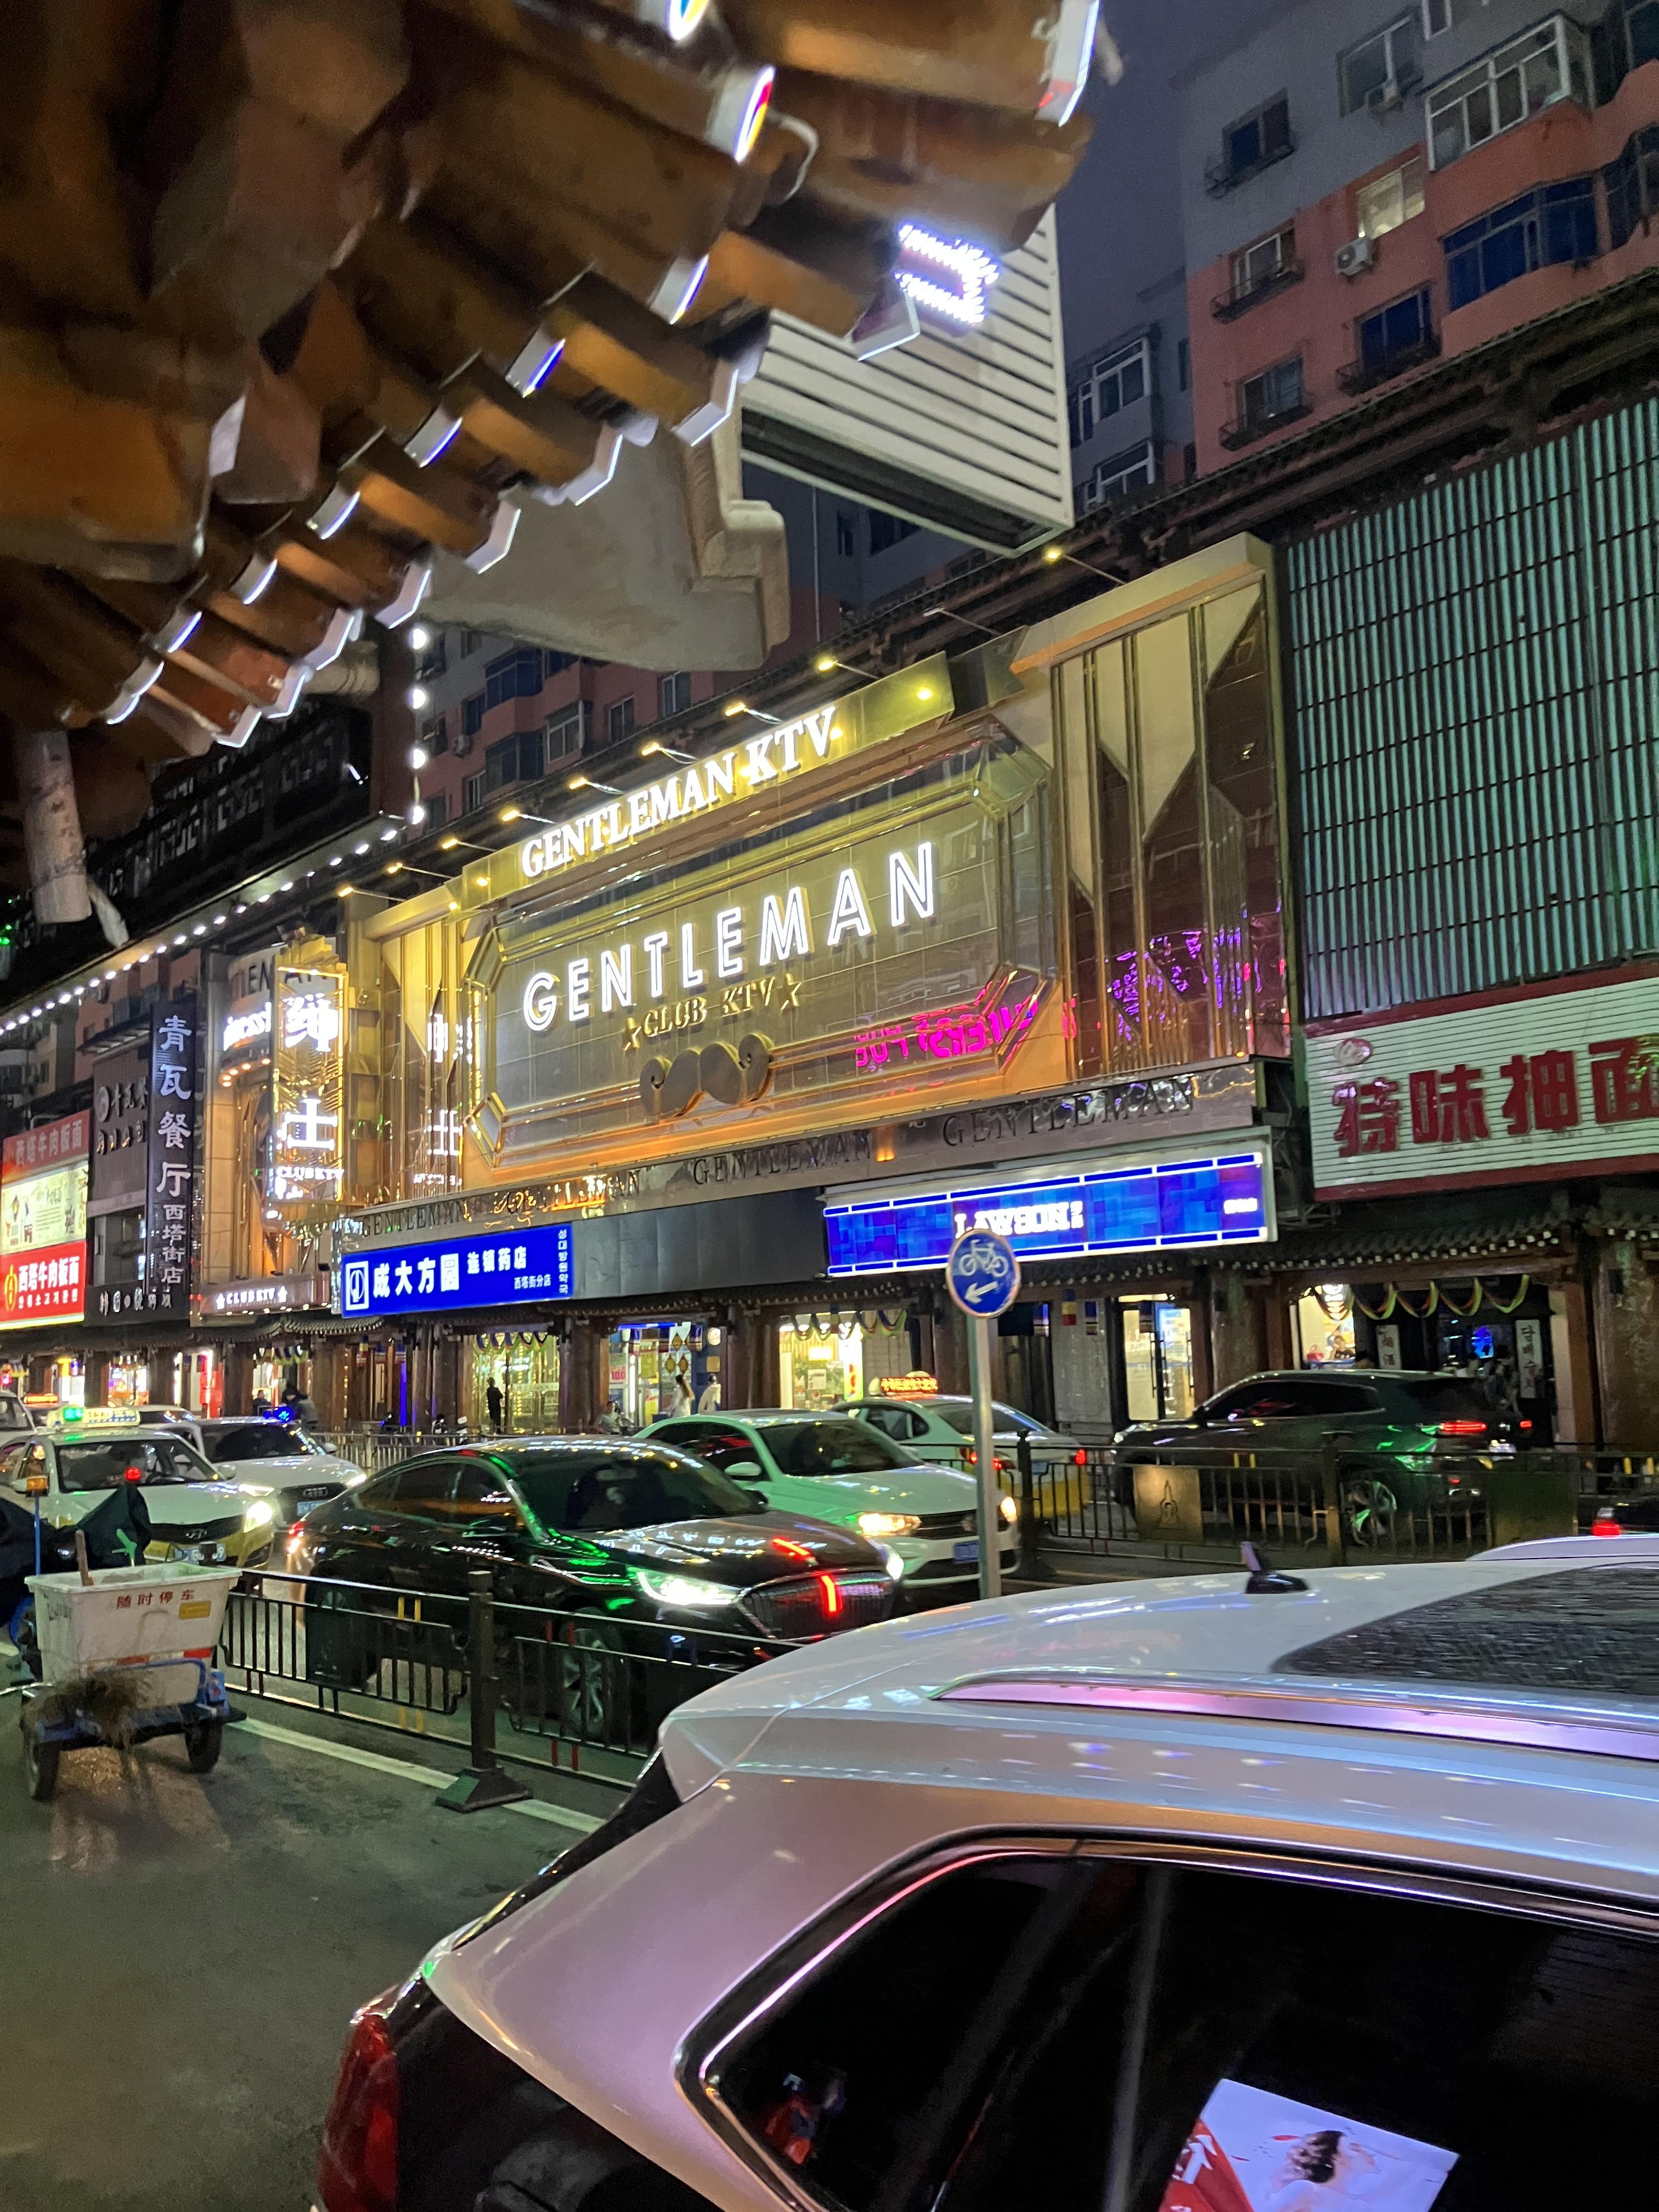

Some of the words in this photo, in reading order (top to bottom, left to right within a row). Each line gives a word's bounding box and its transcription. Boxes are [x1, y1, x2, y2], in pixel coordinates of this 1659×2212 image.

[522, 752, 737, 878] GENTLEMAN
[747, 706, 837, 786] KTV
[522, 841, 935, 1032] GENTLEMAN
[643, 996, 708, 1038] CLUB
[720, 976, 775, 1018] KTV
[156, 1015, 193, 1197] 青瓦餐厅
[943, 1074, 1195, 1147] GENTLEMAN
[693, 1128, 871, 1185] GENTLEMAN
[226, 1290, 255, 1305] CLUB
[373, 1252, 460, 1298] 成大方圆
[117, 1589, 195, 1610] 随时停车
